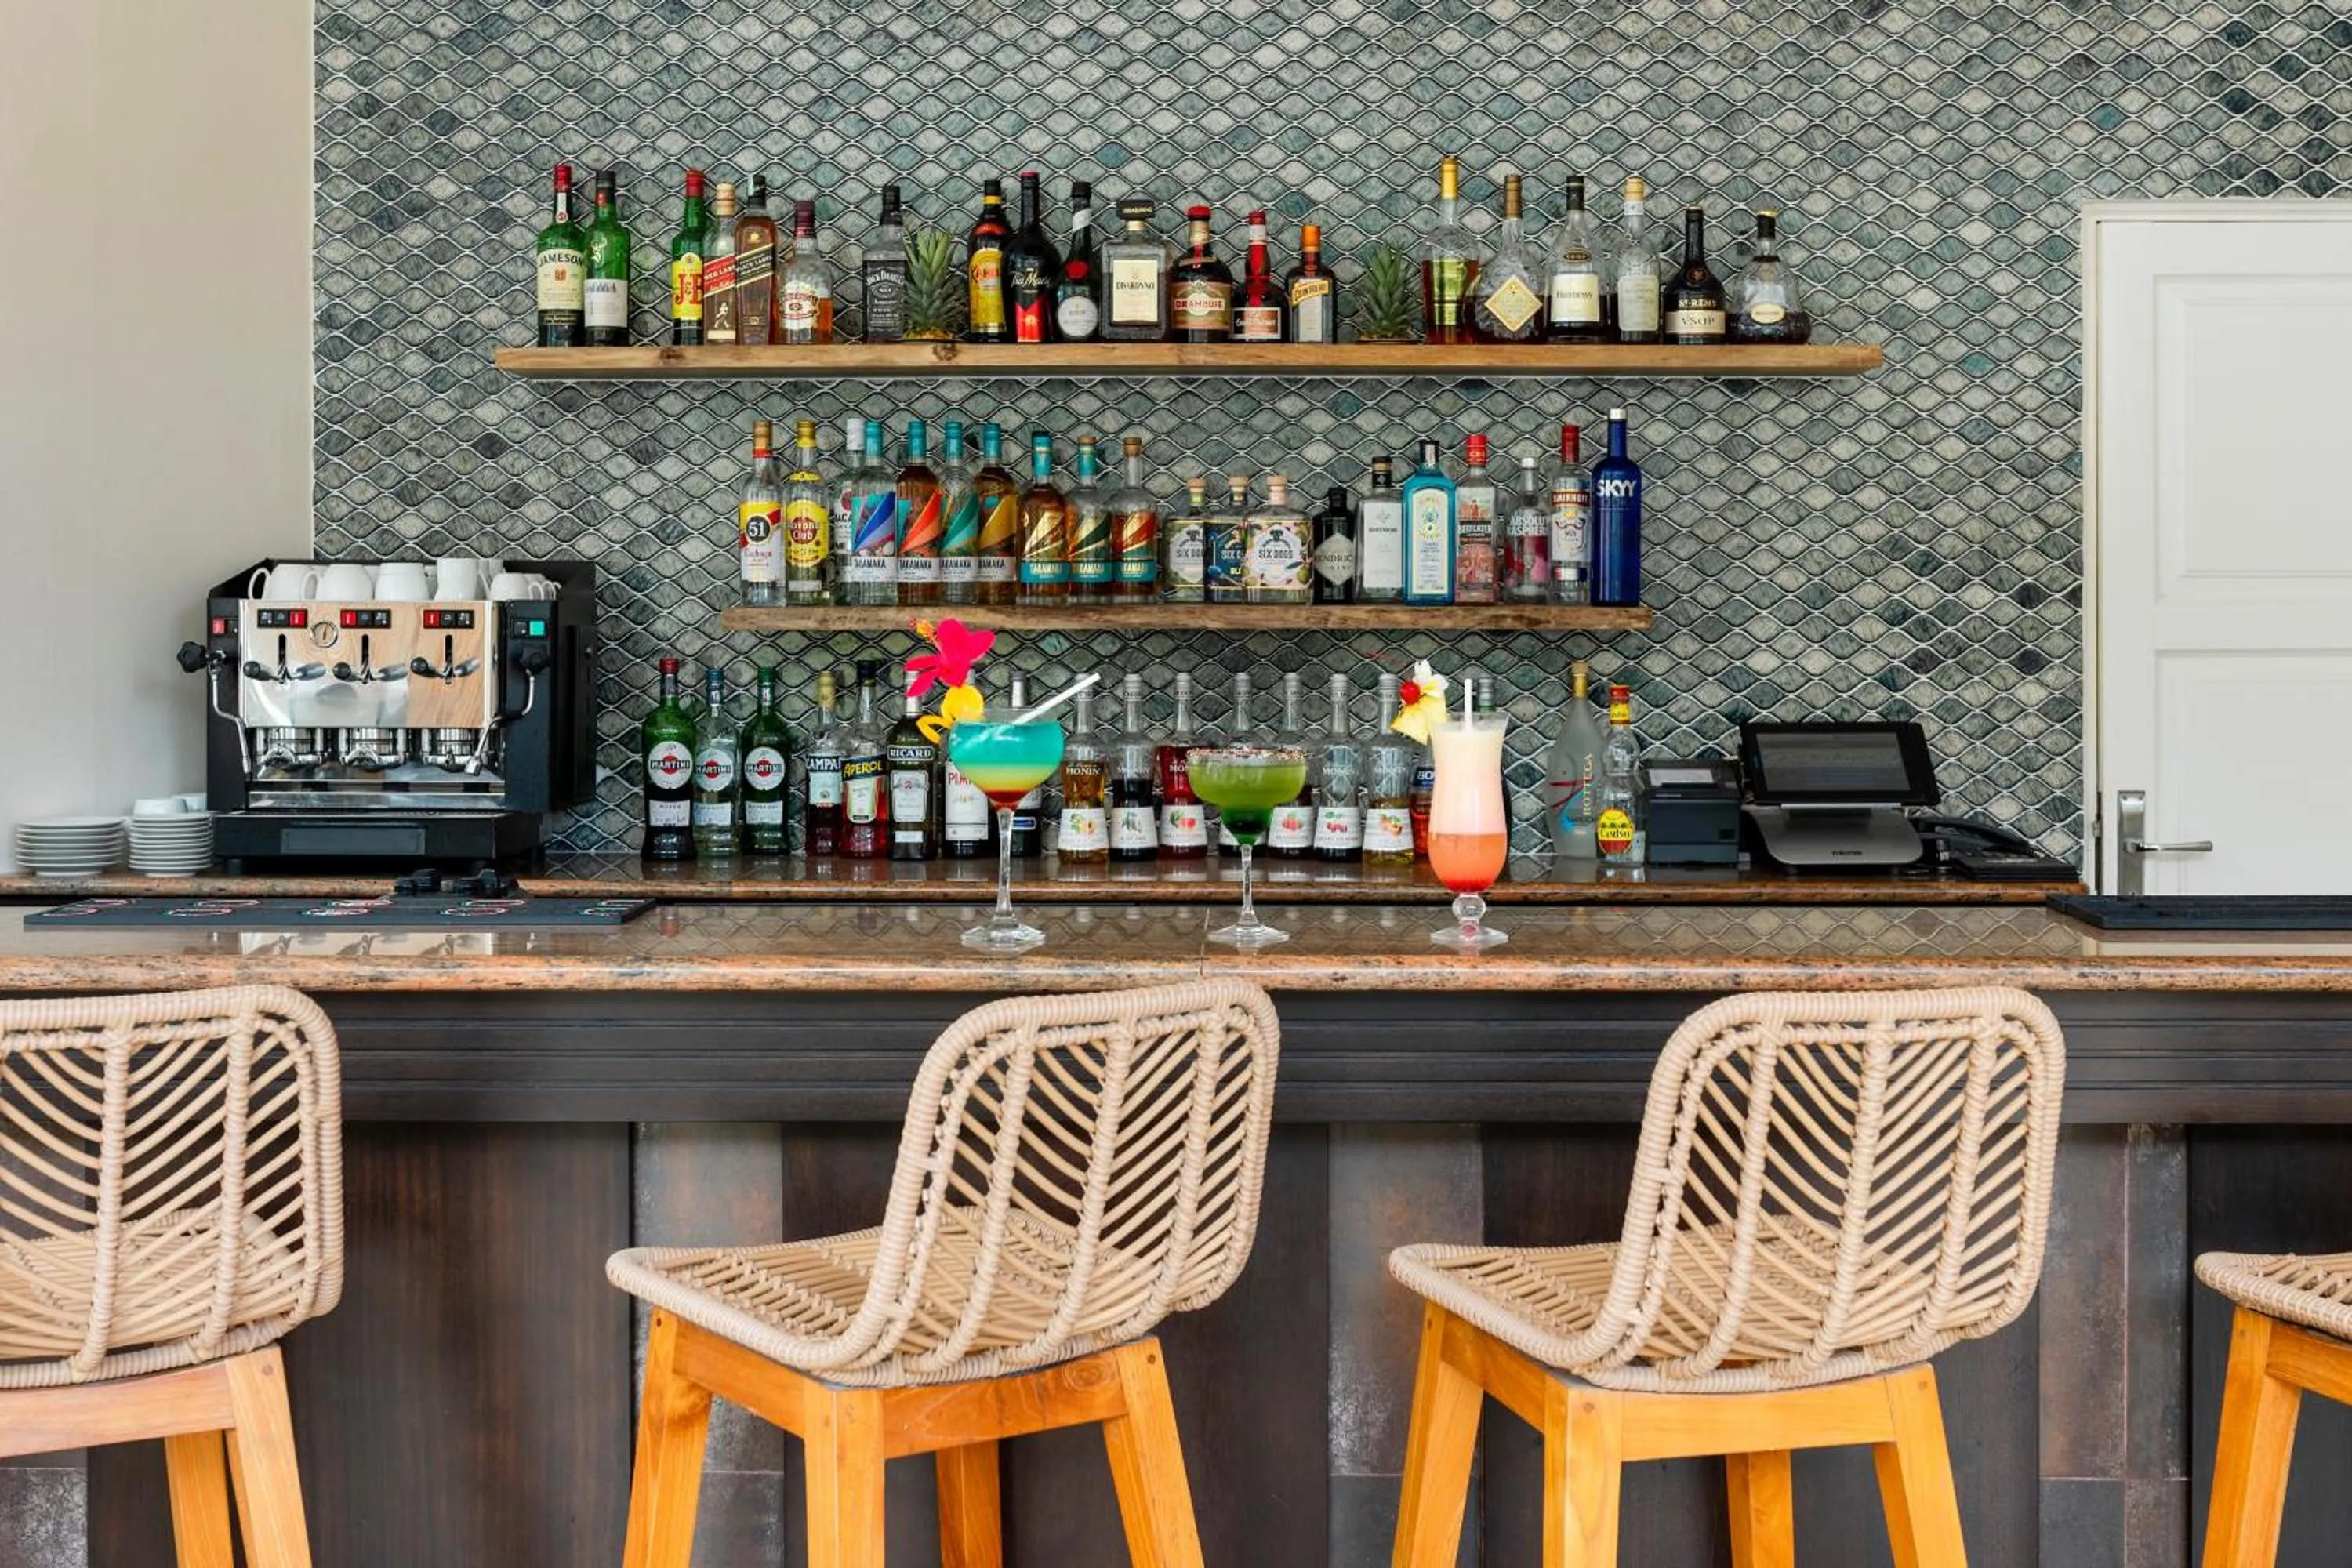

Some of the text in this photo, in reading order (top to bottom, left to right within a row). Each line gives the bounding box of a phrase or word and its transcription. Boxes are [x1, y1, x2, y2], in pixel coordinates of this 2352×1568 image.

[539, 253, 583, 267] JAMESON
[1174, 299, 1224, 309] DRAMBUIE
[1595, 479, 1638, 497] SKYY
[748, 521, 766, 537] 51
[1258, 549, 1294, 559] SIX DOGS
[890, 749, 931, 757] RICARD
[651, 760, 691, 770] MARTINI
[695, 764, 731, 774] MARTINI
[746, 764, 782, 773] MARTINI
[843, 760, 883, 777] APEROL
[1066, 765, 1101, 775] MONIN
[1583, 753, 1593, 815] BOTTEGA
